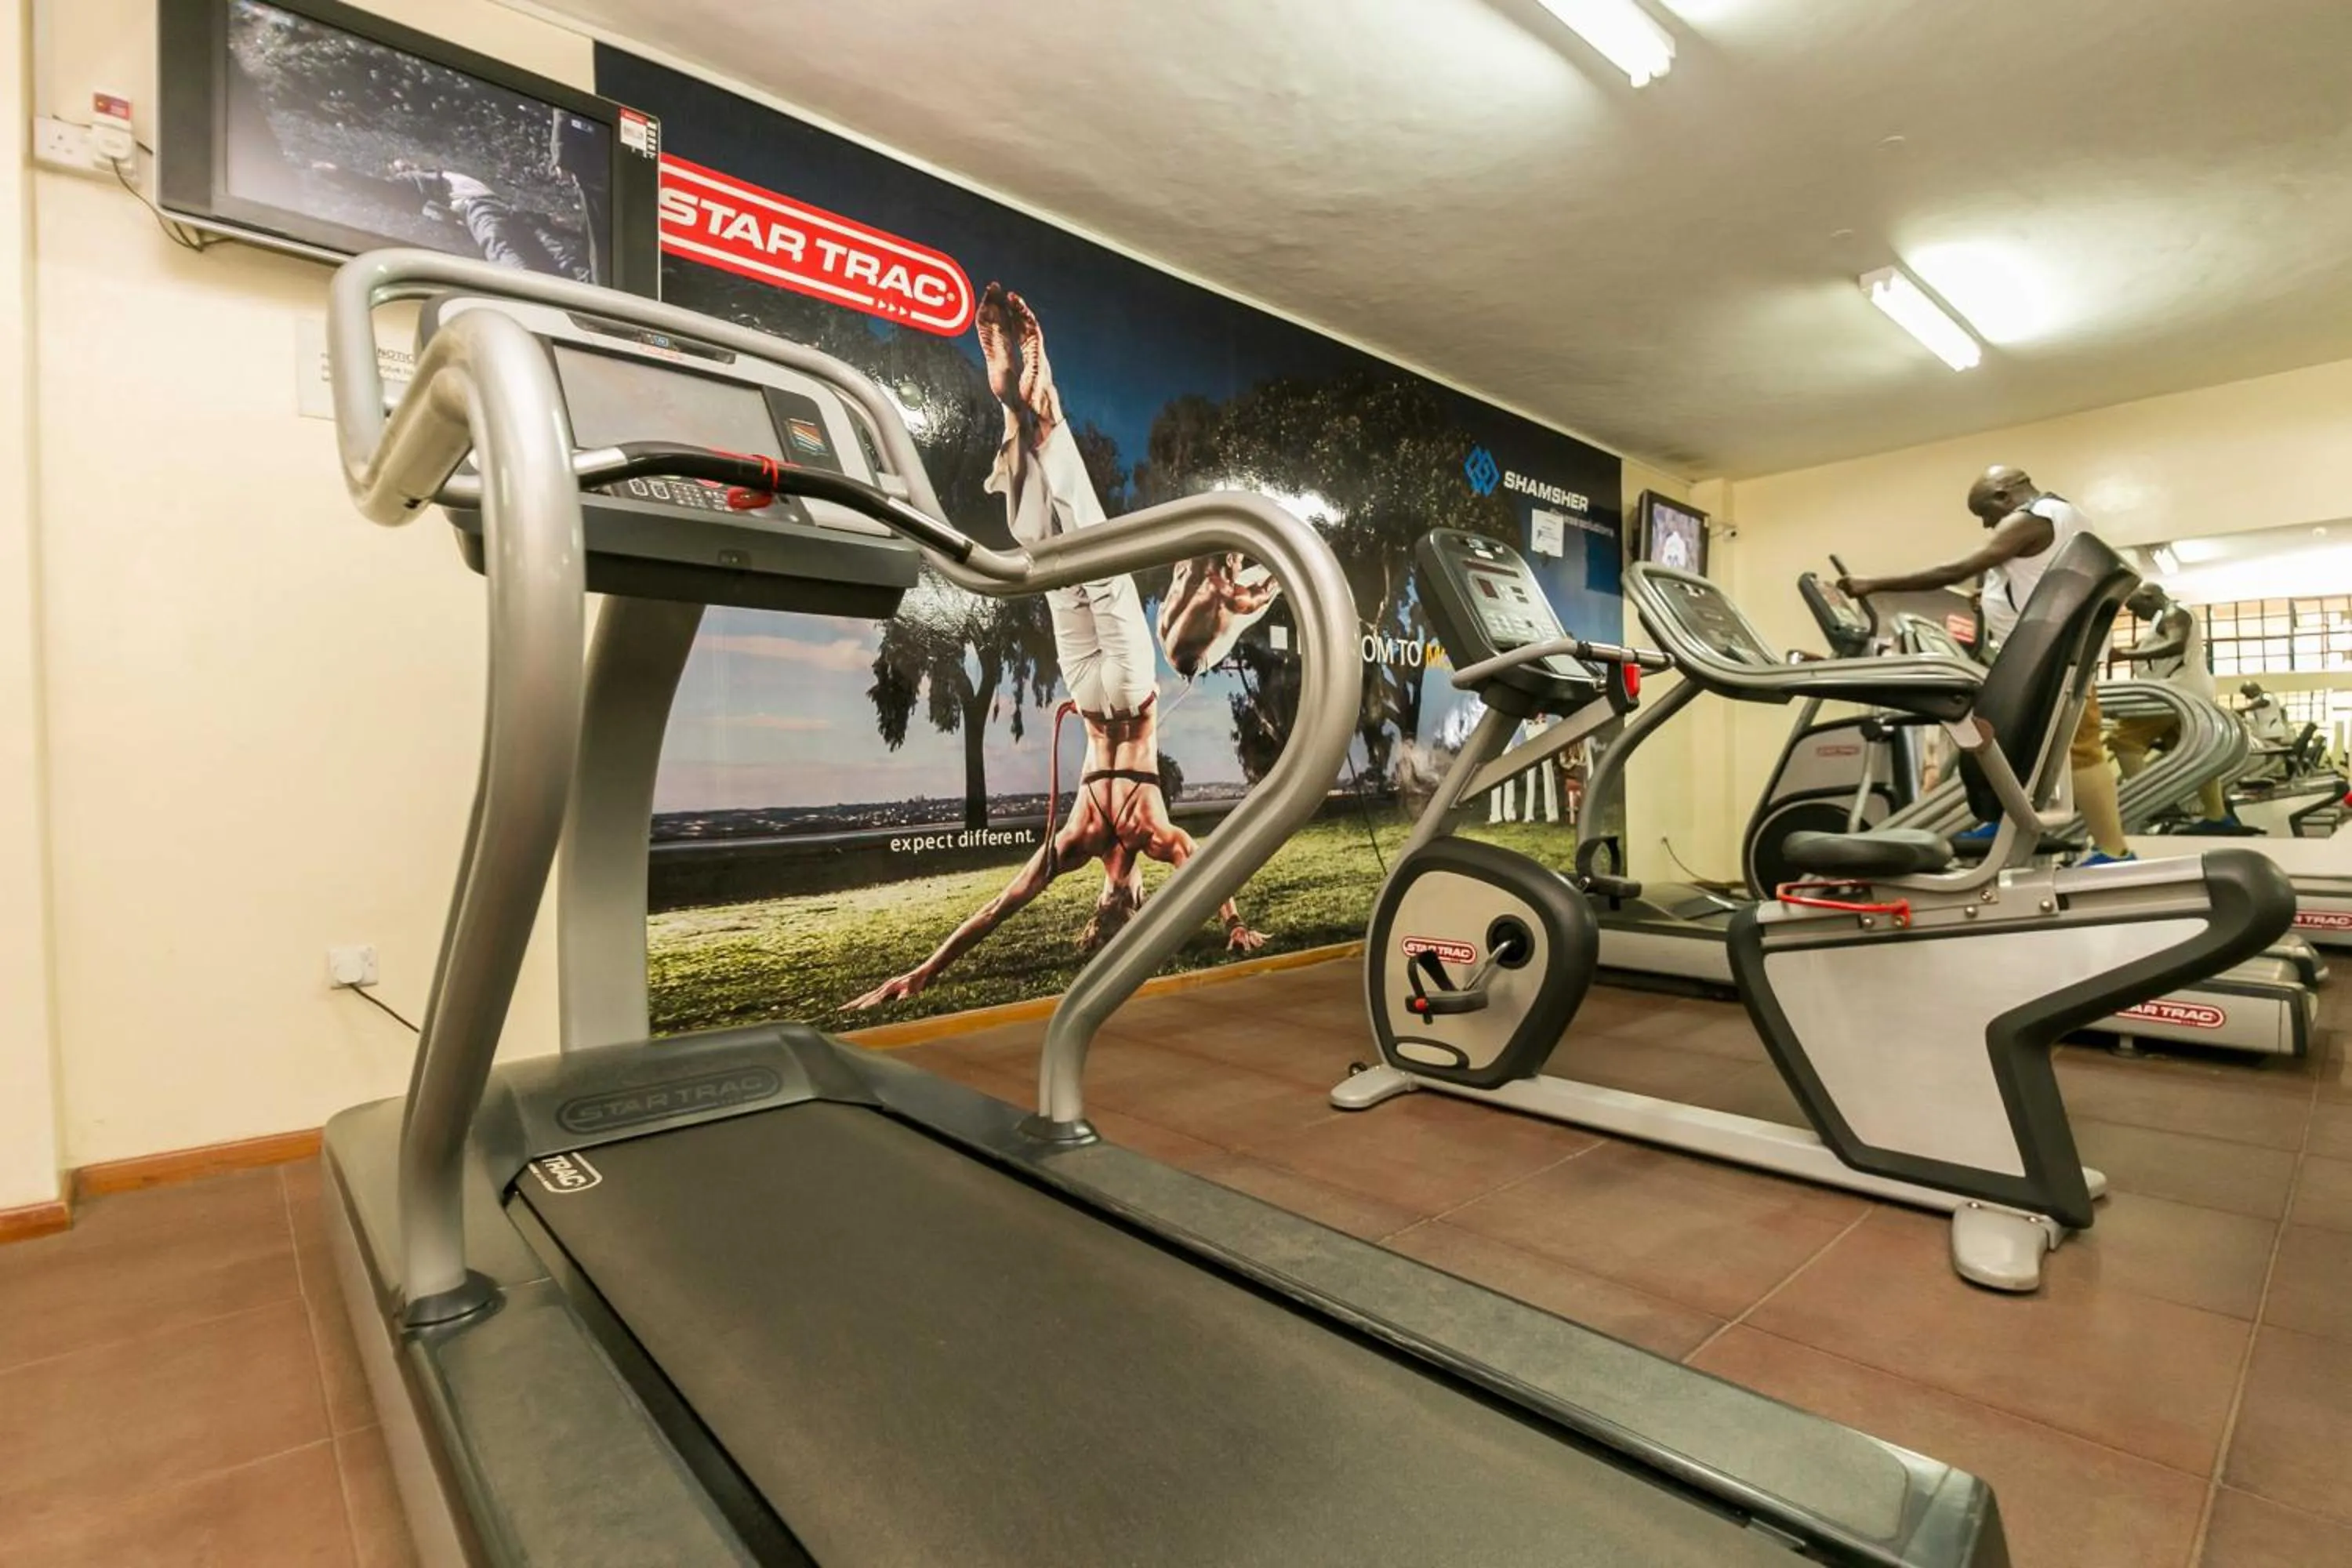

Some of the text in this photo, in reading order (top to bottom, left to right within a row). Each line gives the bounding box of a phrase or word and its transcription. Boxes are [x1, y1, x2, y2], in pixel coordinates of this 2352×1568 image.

[660, 187, 947, 307] STAR TRAC
[377, 347, 415, 364] NOTIC
[1503, 470, 1589, 513] SHAMSHER
[1396, 638, 1422, 666] TO
[890, 833, 953, 855] expect
[1438, 946, 1471, 958] TRAC
[2160, 1006, 2215, 1022] TRAC
[579, 1076, 763, 1120] STAR TRAC
[542, 1155, 586, 1188] TRAC
